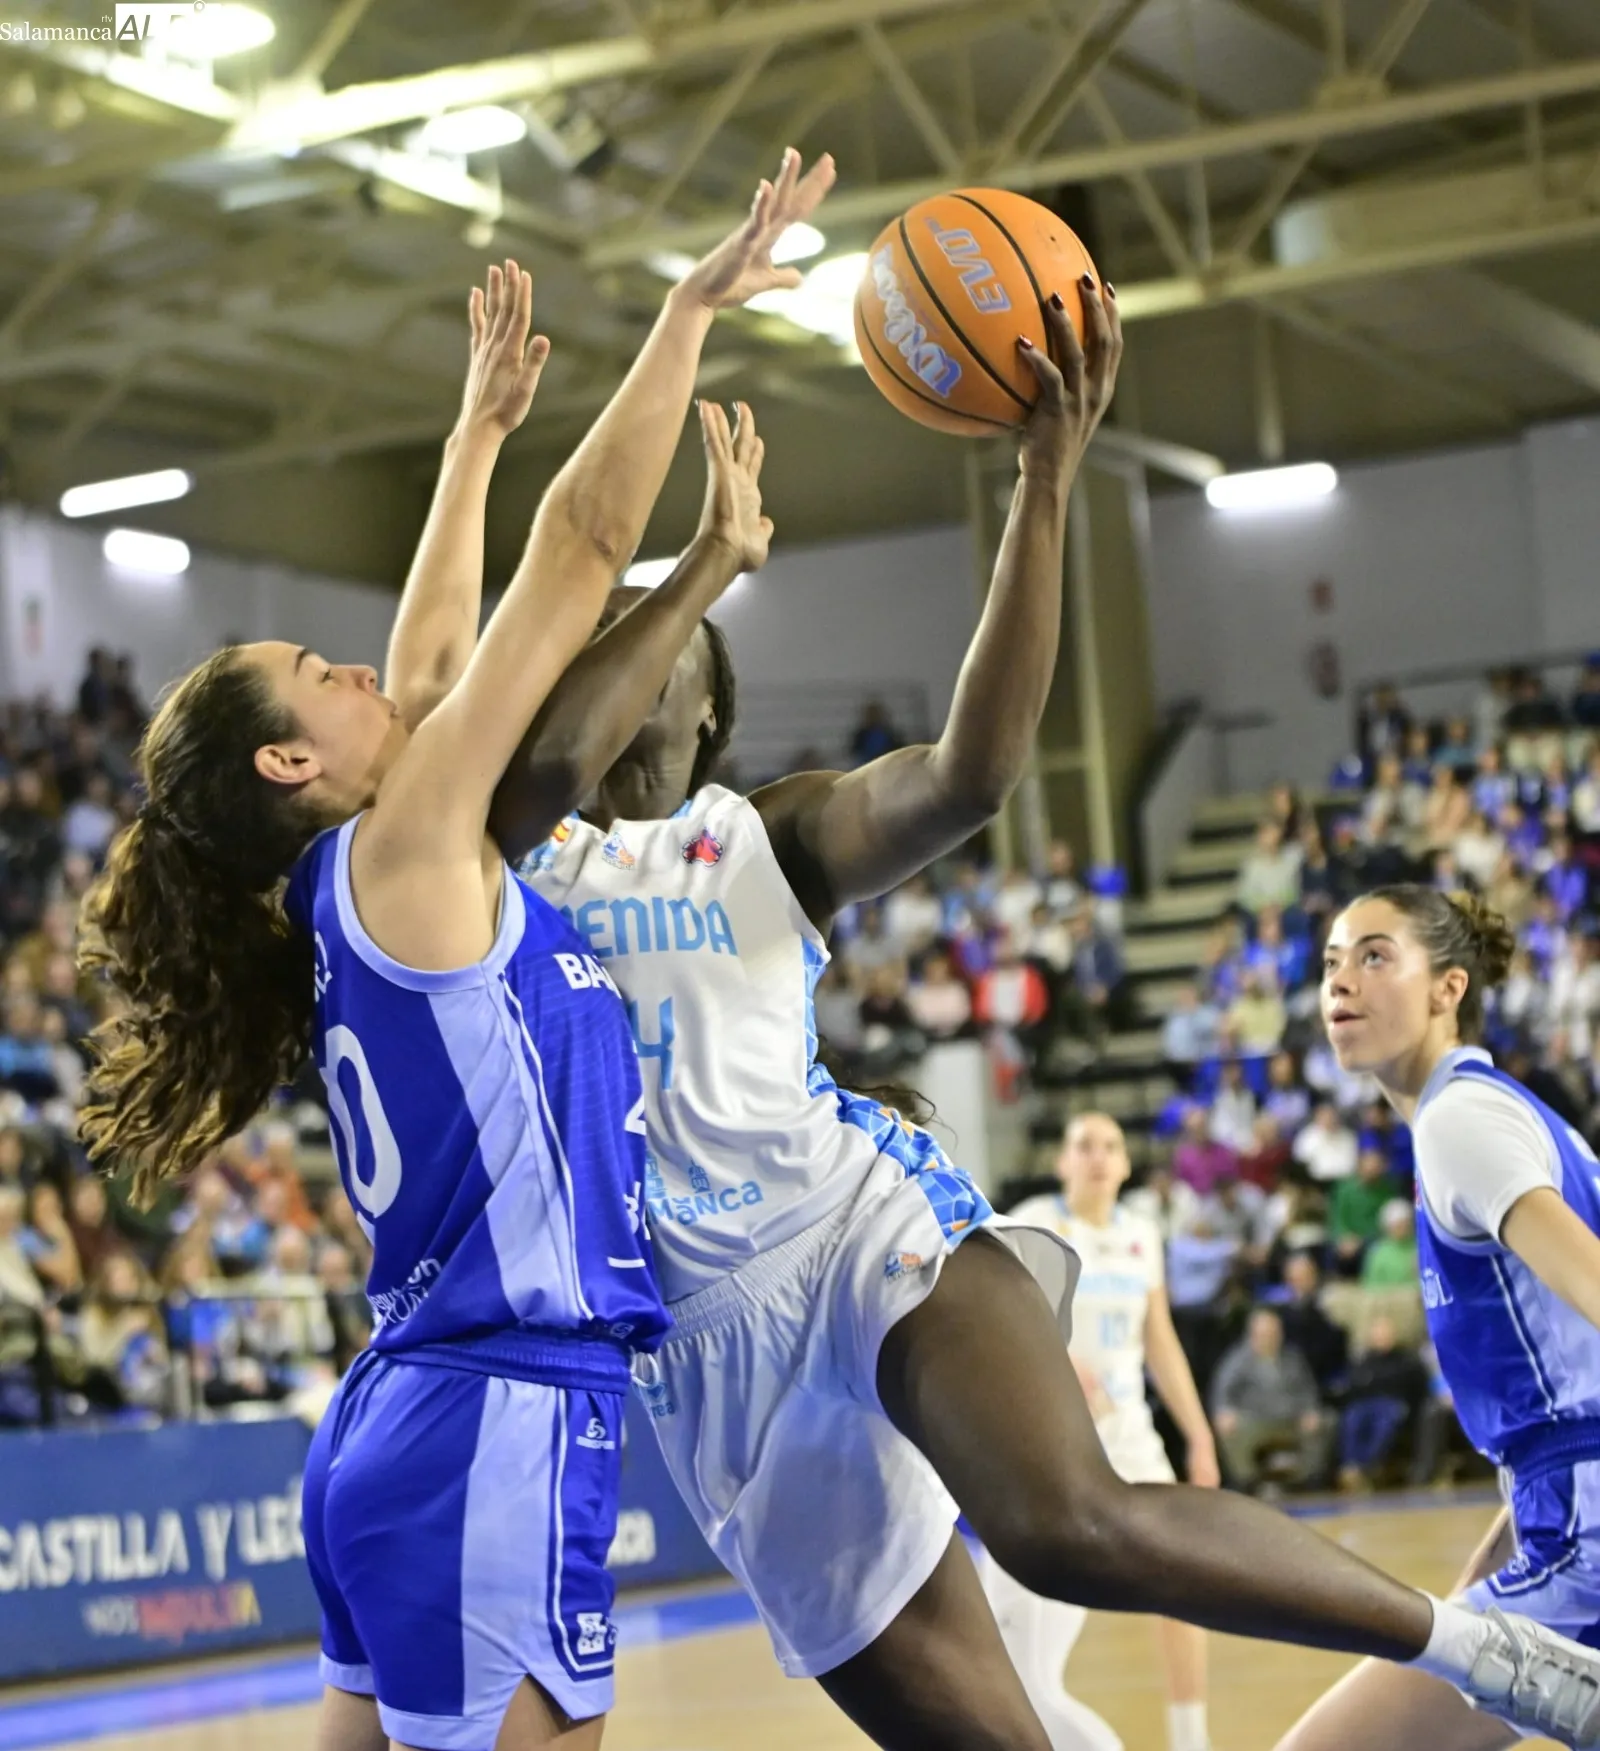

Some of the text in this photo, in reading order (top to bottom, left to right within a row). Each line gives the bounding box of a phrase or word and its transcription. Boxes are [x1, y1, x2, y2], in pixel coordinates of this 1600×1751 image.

[872, 243, 963, 398] Wilson
[557, 896, 738, 957] ENIDA
[0, 1509, 190, 1592] CASTILLA
[196, 1499, 232, 1583] Y
